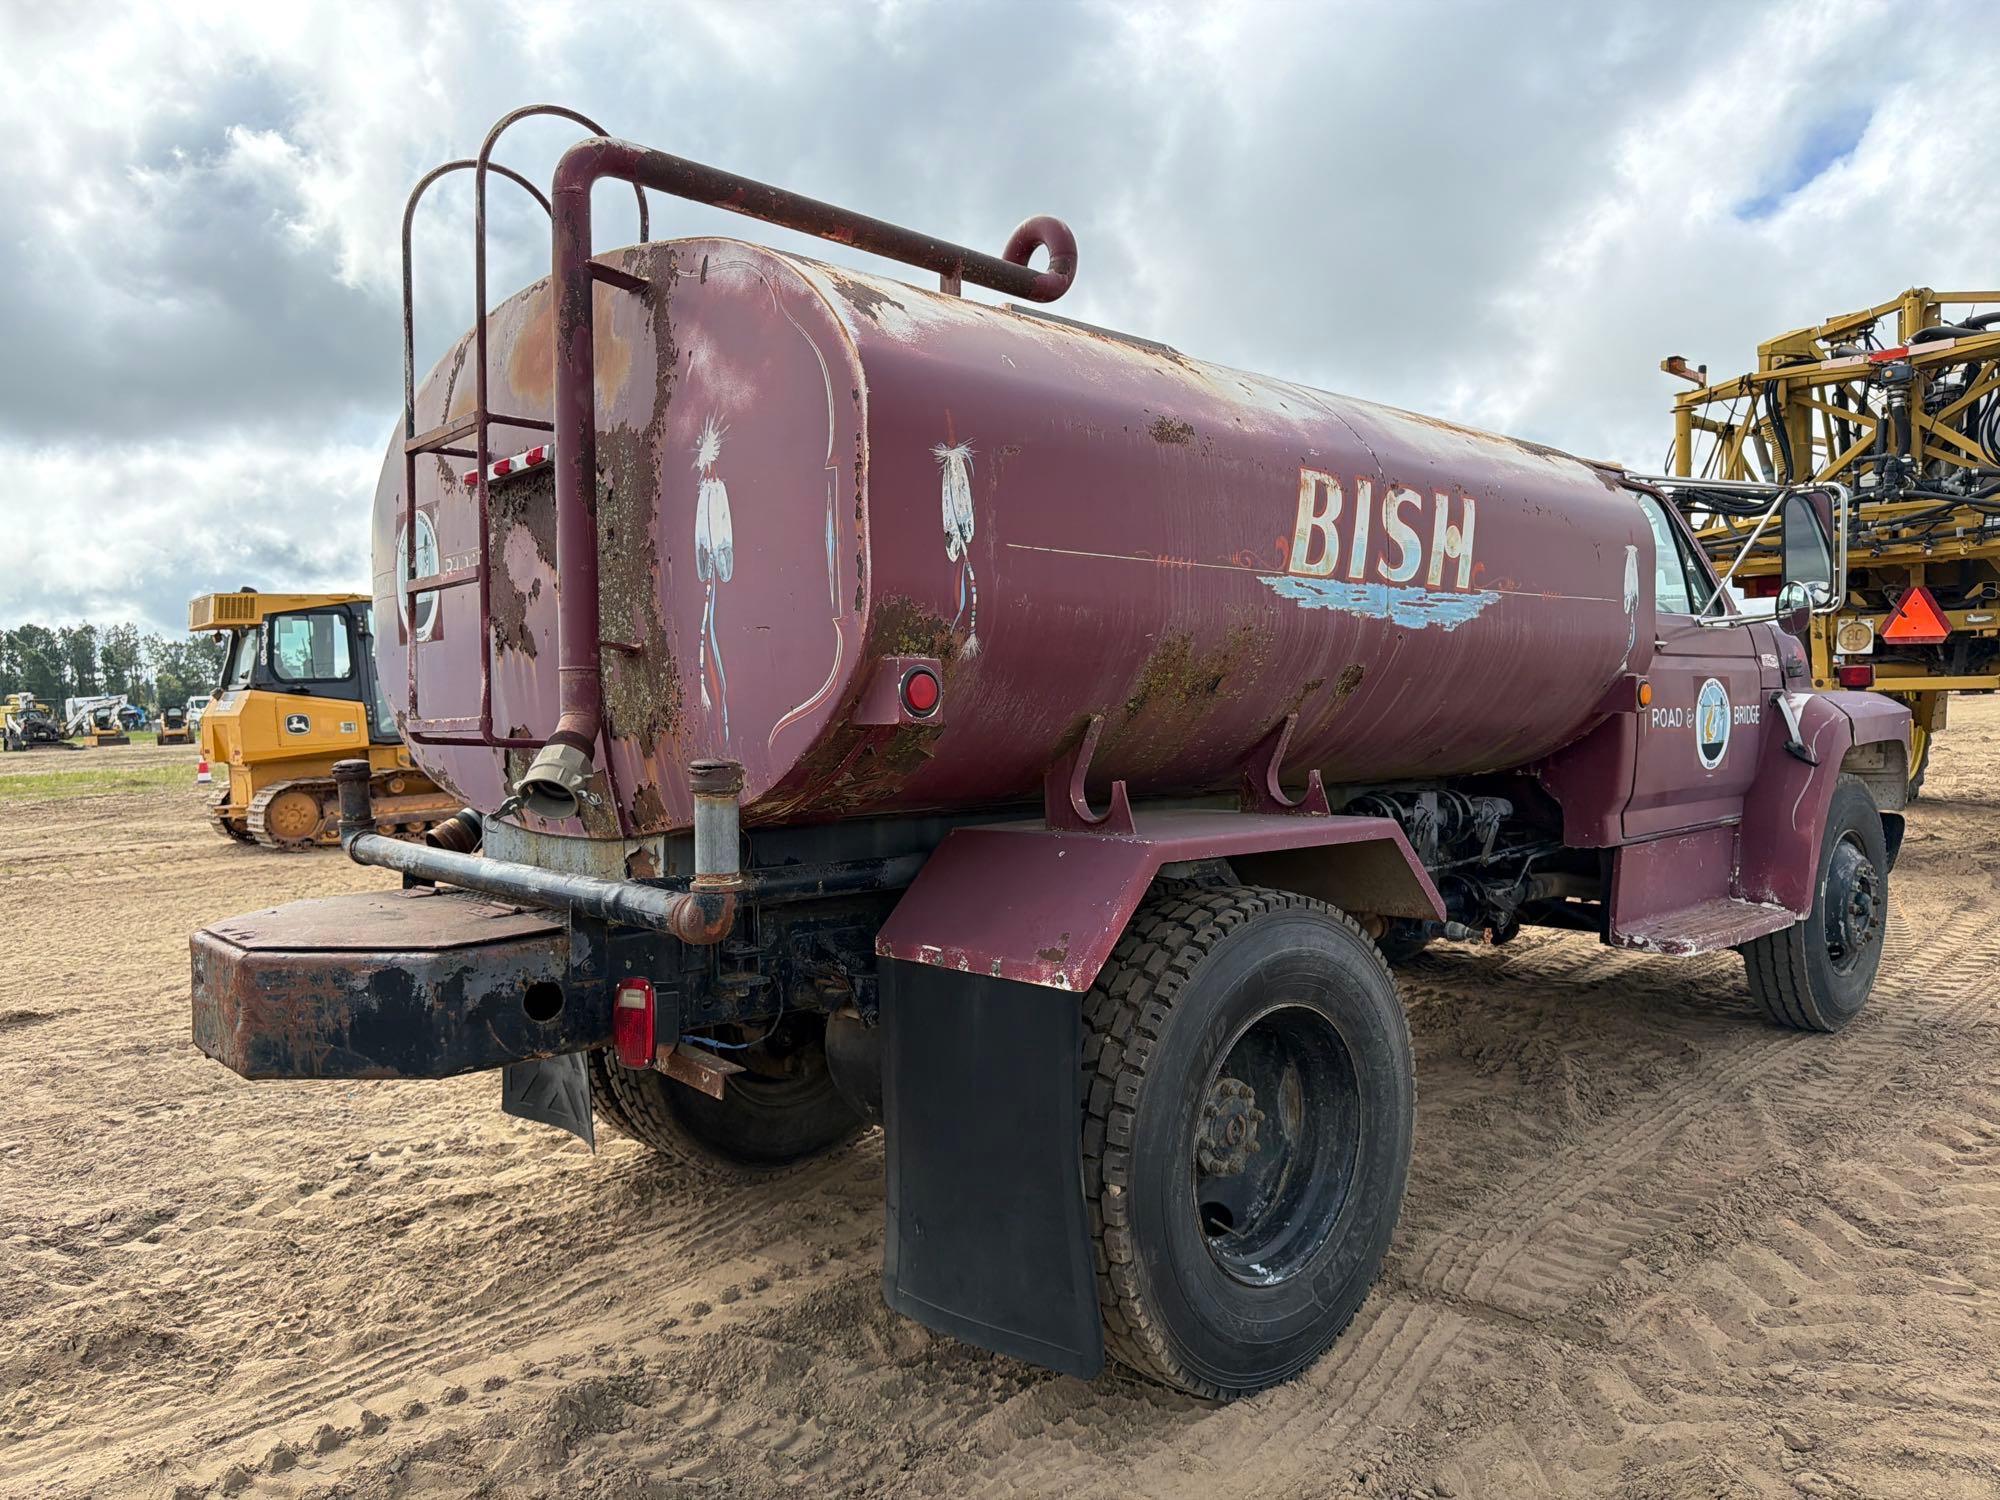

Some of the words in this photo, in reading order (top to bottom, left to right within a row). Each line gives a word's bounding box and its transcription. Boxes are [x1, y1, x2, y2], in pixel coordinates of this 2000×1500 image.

[1288, 467, 1476, 590] BISH
[1652, 707, 1683, 728] ROAD
[1686, 707, 1695, 729] &
[1734, 704, 1760, 725] BRIDGE
